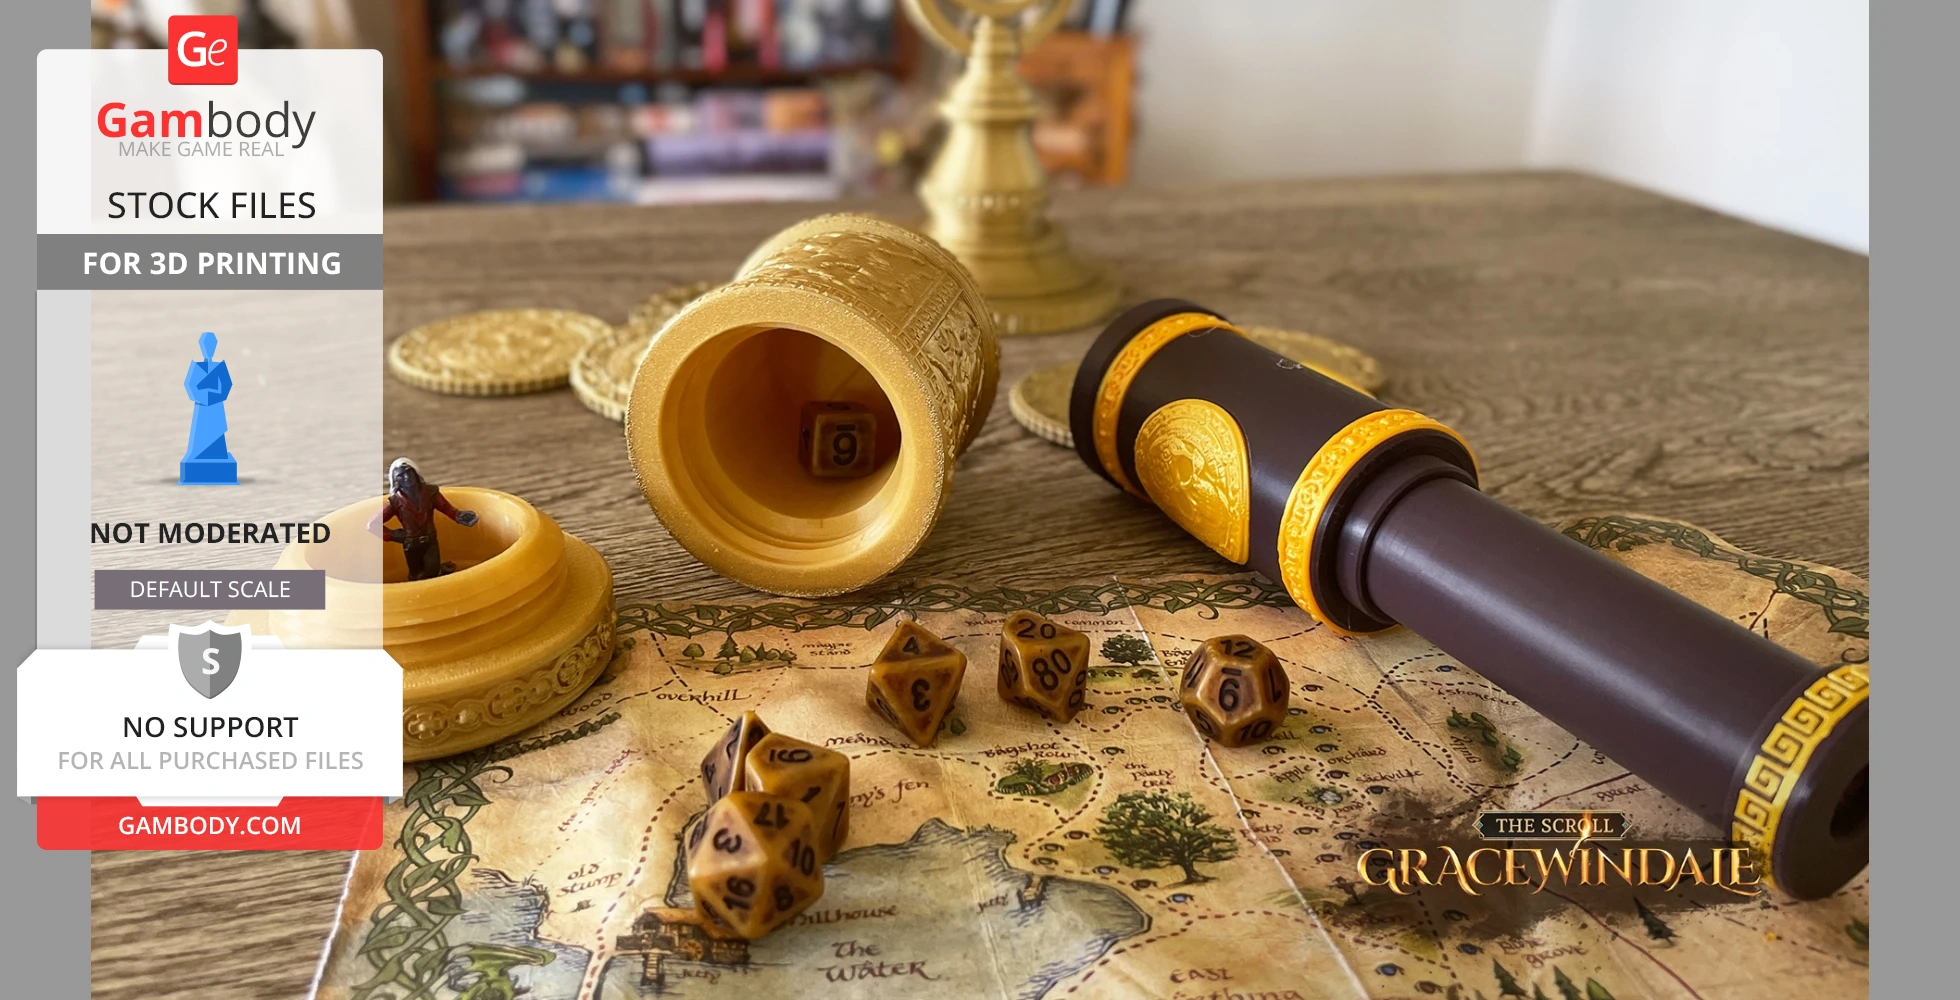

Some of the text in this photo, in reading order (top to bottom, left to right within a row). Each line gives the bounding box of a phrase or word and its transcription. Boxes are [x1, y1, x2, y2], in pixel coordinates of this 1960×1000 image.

[1017, 618, 1056, 639] 20
[903, 636, 920, 655] 4
[1220, 639, 1256, 659] 12
[1032, 648, 1072, 690] 80
